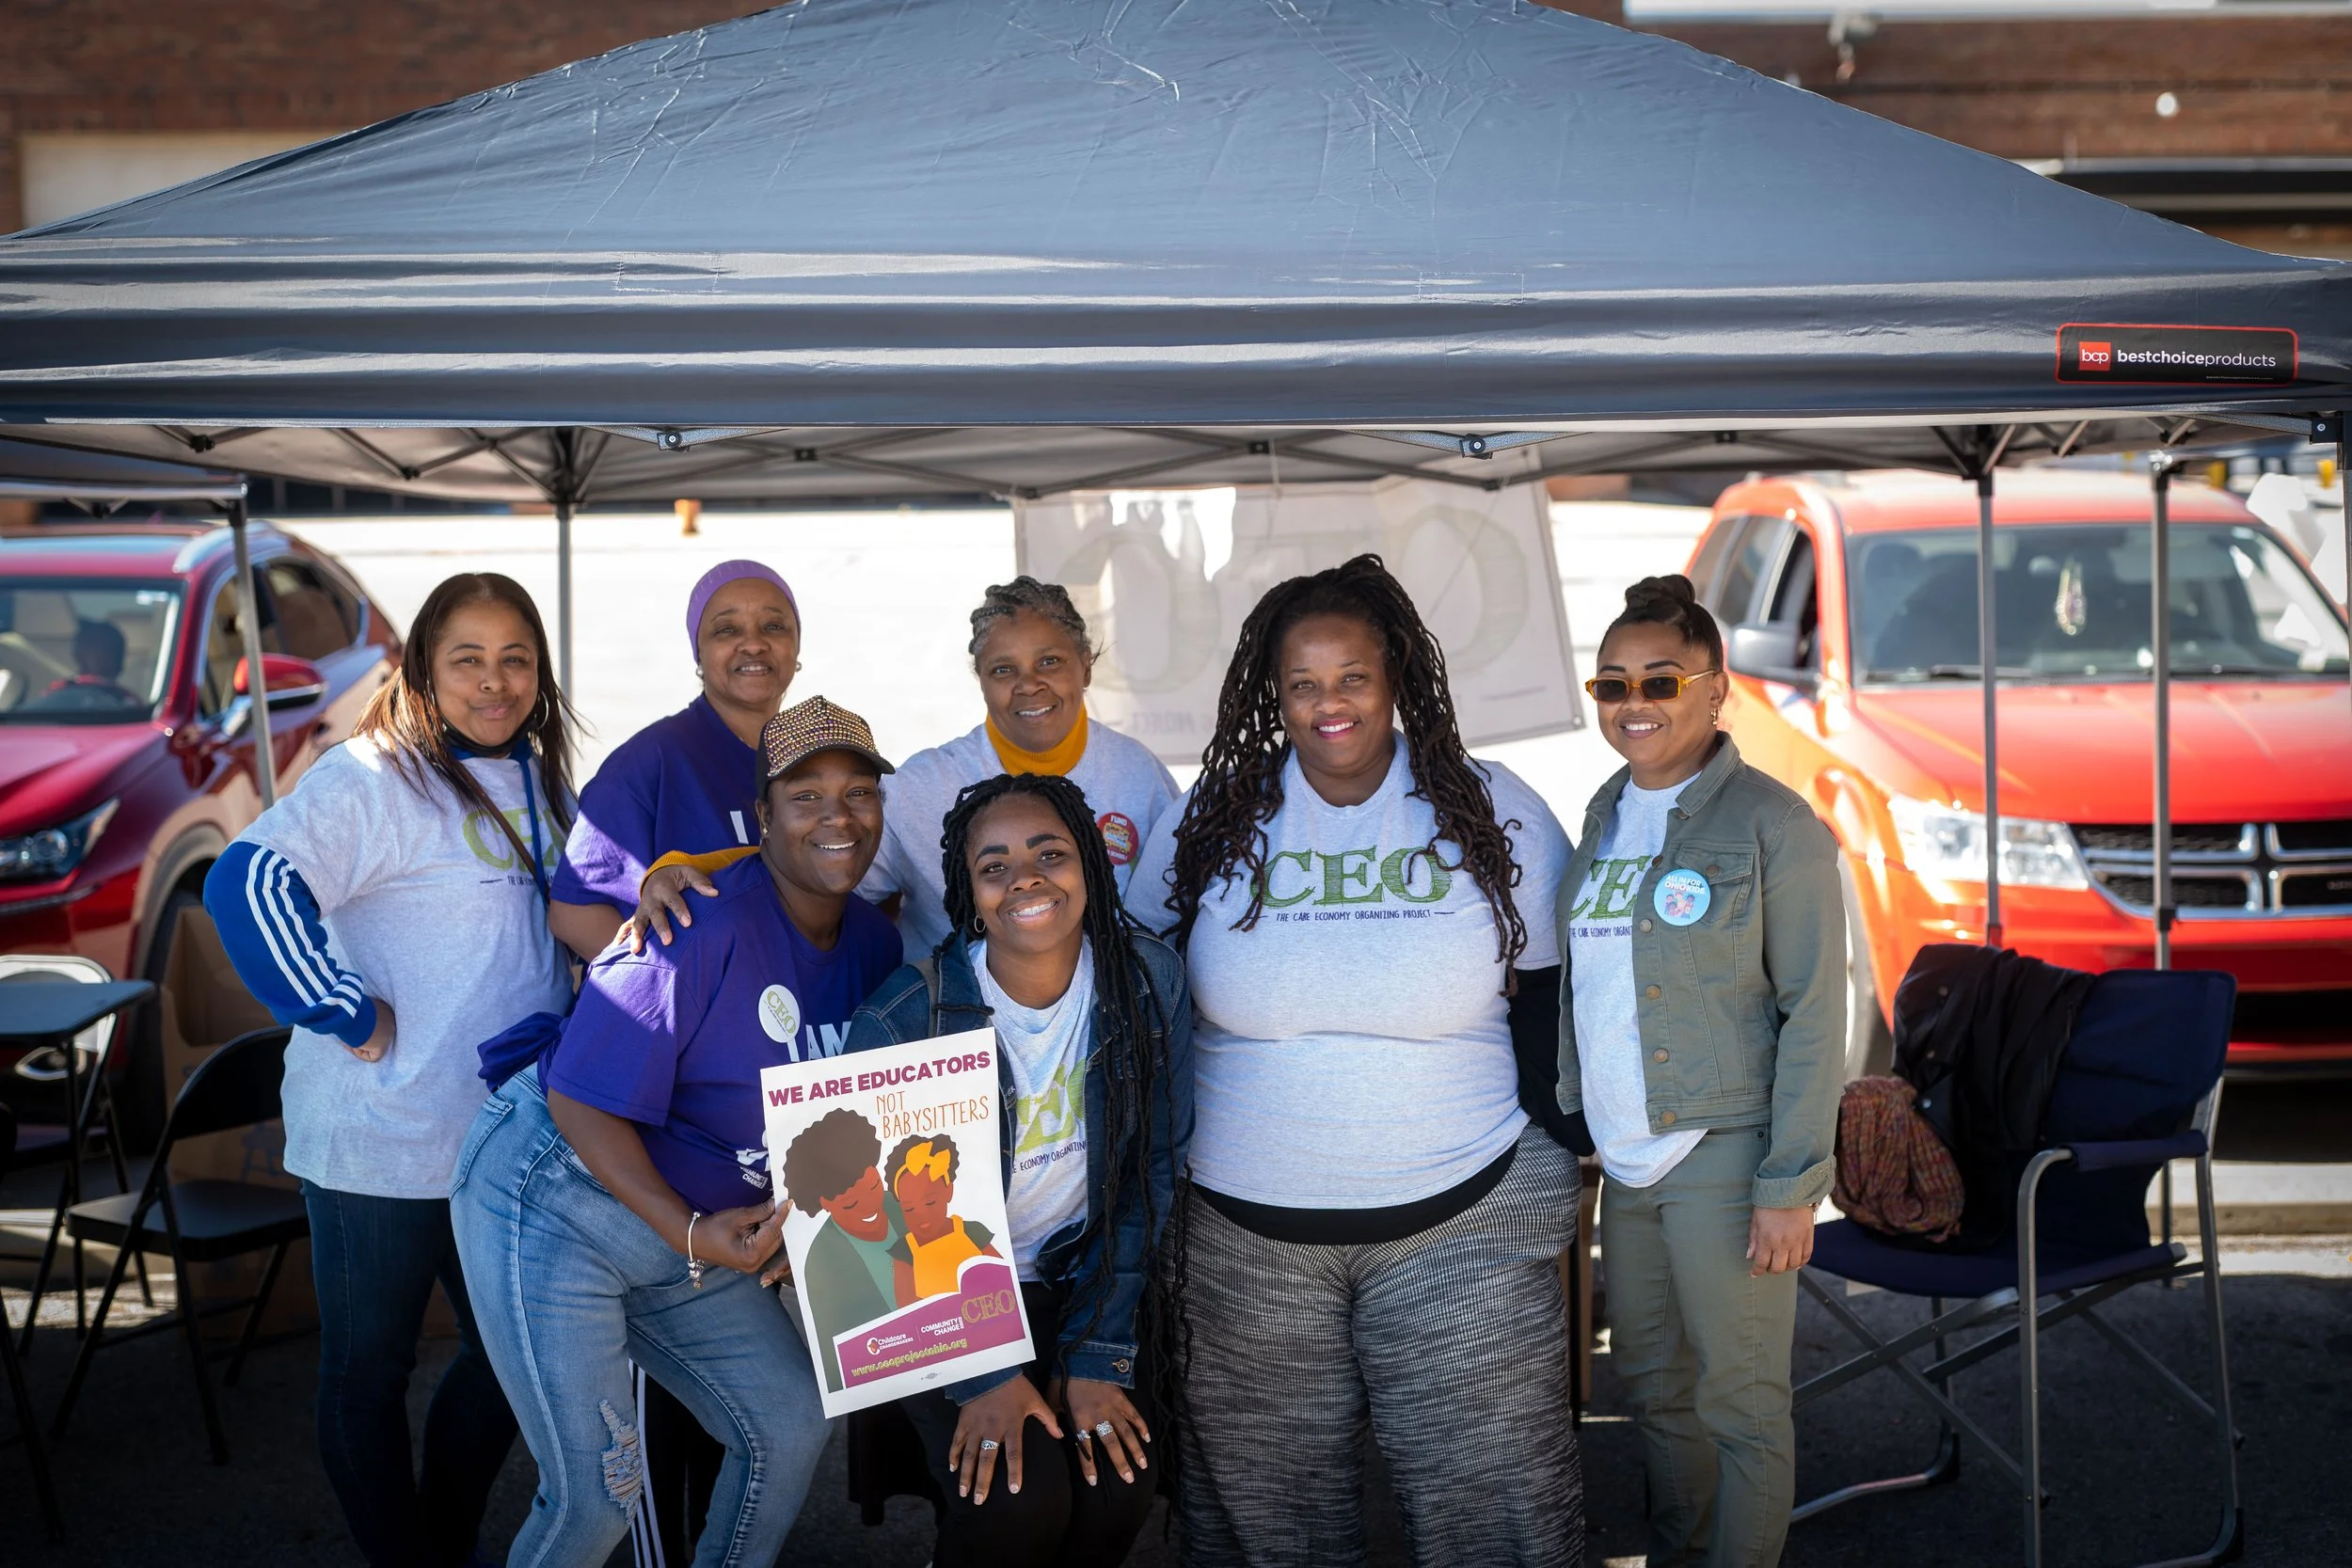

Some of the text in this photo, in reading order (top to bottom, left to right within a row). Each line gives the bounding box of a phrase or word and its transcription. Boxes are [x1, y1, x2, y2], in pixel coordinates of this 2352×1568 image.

[2082, 349, 2109, 365] bcp
[2117, 349, 2277, 367] bestchoiceproducts
[1249, 845, 1454, 909] CEO
[1276, 909, 1431, 922] THE CARE ECONOMY ORGANIZING PROJECT
[1590, 927, 1612, 938] ECONOMY
[767, 990, 797, 1034] CEO
[769, 1051, 992, 1107] WE ARE EDUCATORS
[876, 1090, 906, 1115] NOT
[882, 1096, 990, 1139] BABYSITTERS
[1020, 1153, 1051, 1171] ECONOMY
[961, 1289, 1016, 1323] CEO
[920, 1318, 959, 1333] COMMUNITY
[933, 1323, 960, 1337] CHANGE
[878, 1333, 907, 1346] Childcare
[851, 1337, 968, 1377] www.ceoprojectohio.org
